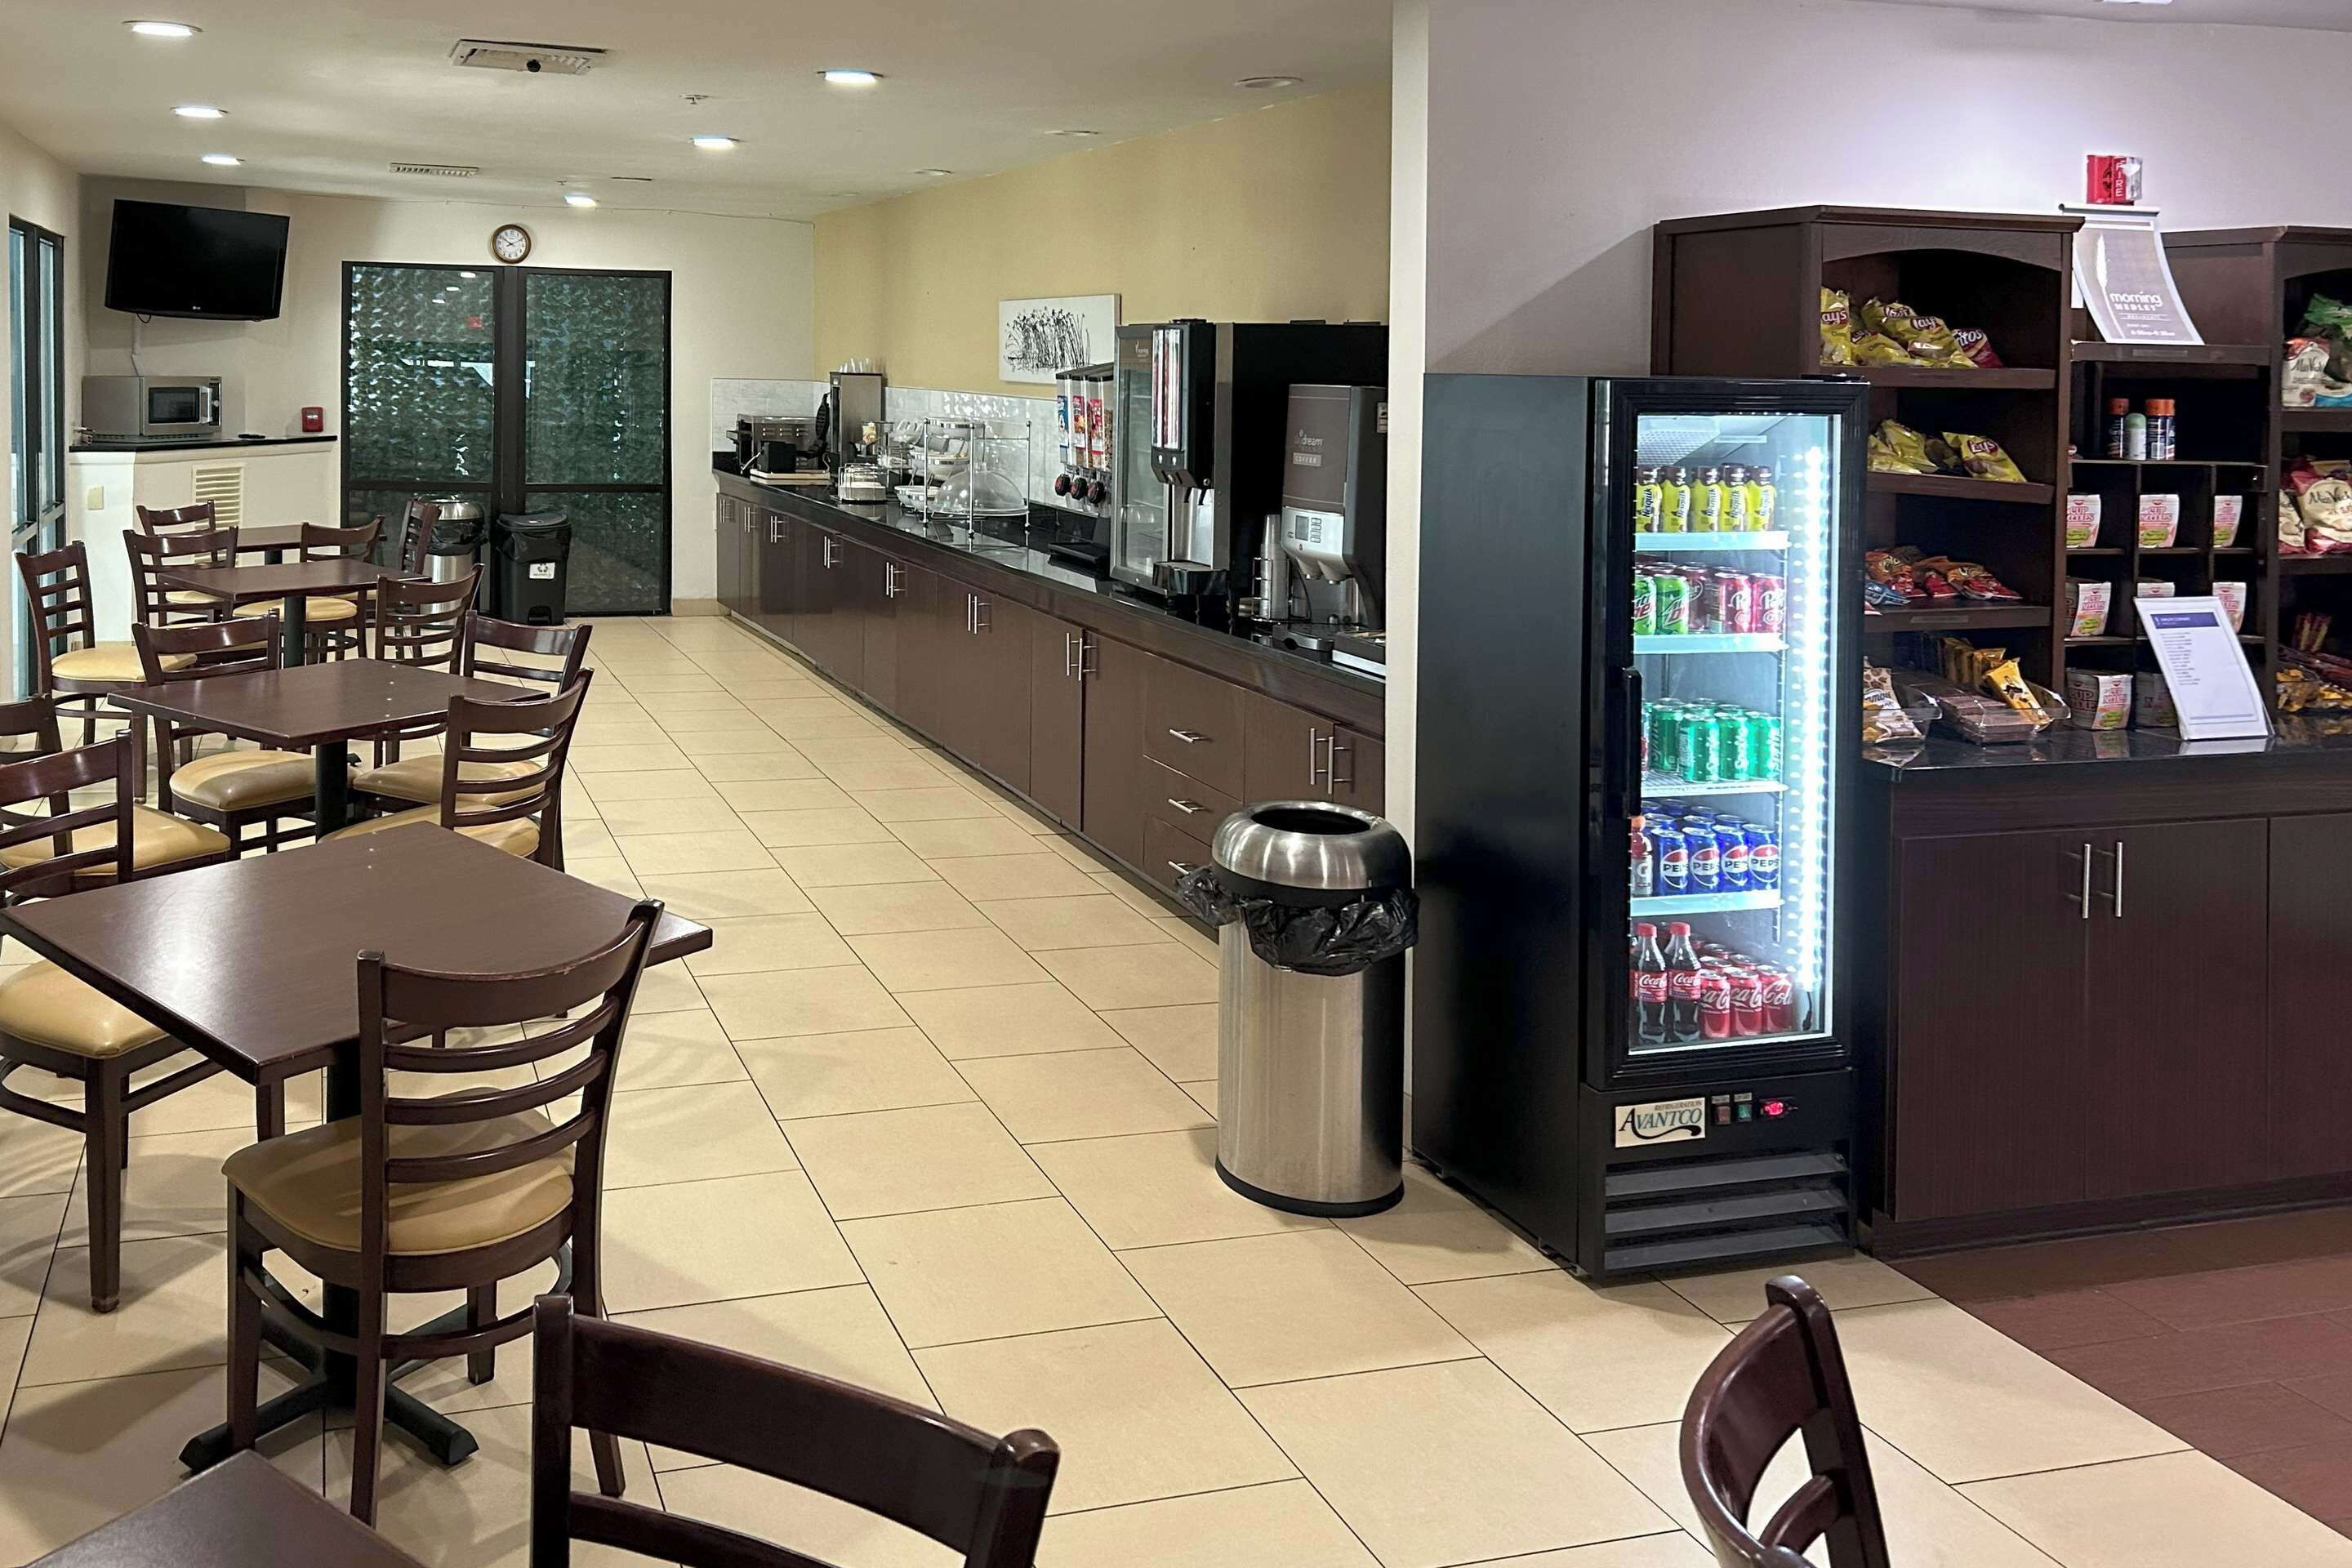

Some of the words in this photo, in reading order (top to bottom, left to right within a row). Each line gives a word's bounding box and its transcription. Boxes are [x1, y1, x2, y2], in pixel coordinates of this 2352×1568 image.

[2109, 292, 2163, 307] morning
[2114, 303, 2157, 311] MEDLEY
[1642, 488, 1654, 517] Nesquik
[1619, 1108, 1702, 1139] AVANTCO
